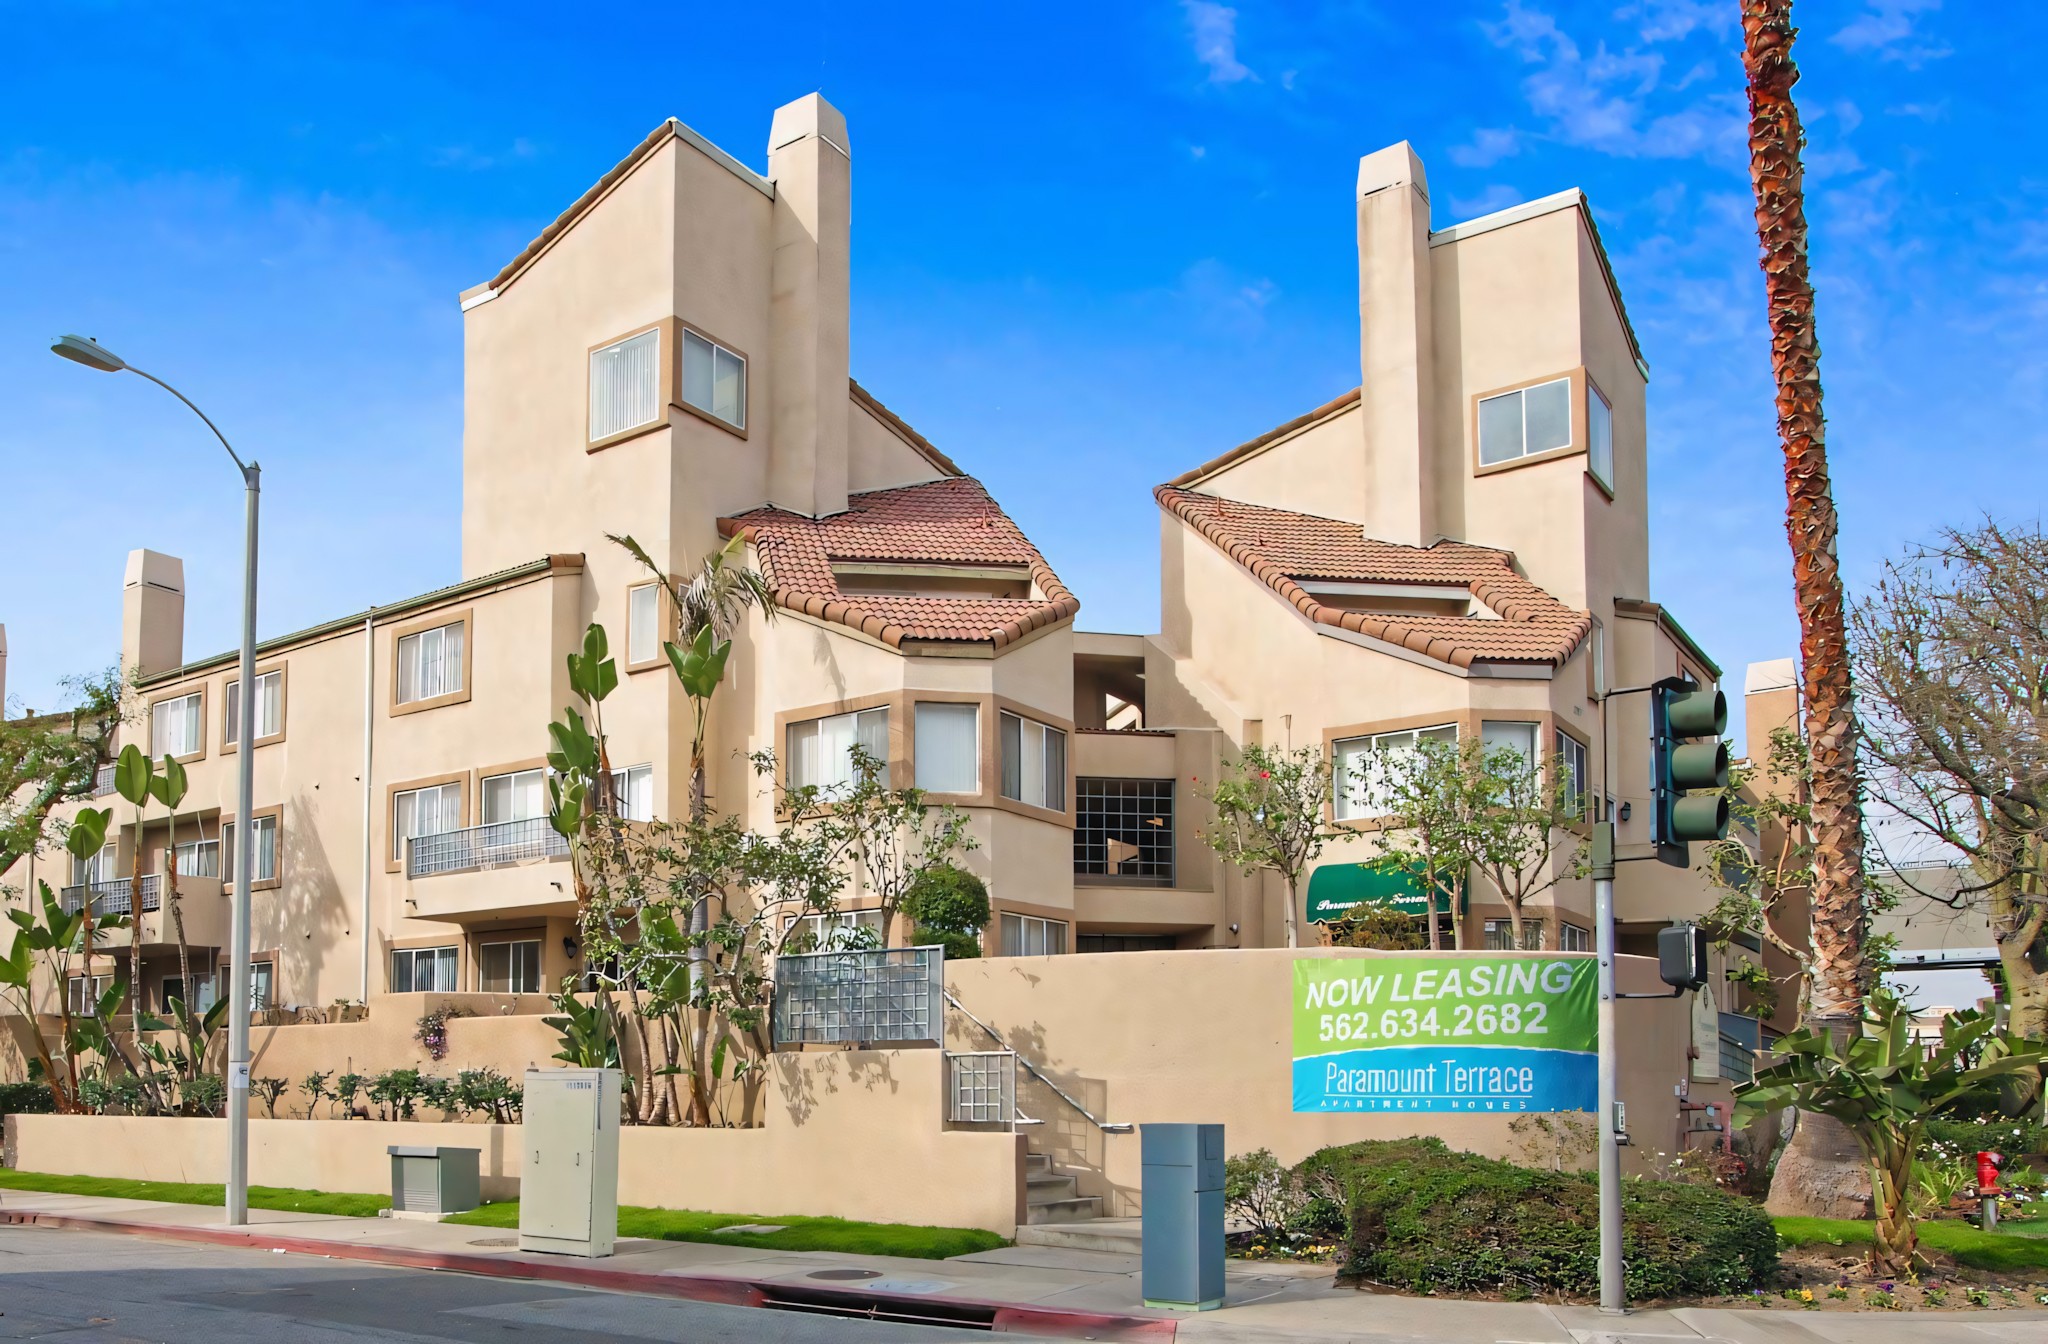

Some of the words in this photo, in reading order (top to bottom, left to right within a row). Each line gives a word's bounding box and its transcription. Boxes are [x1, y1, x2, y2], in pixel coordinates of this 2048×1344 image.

[1305, 975, 1384, 1009] NOW
[1389, 961, 1574, 1002] LEASING
[1319, 1001, 1549, 1041] 562.634.2682
[1325, 1061, 1437, 1093] Paramount
[1441, 1059, 1534, 1093] Terrace
